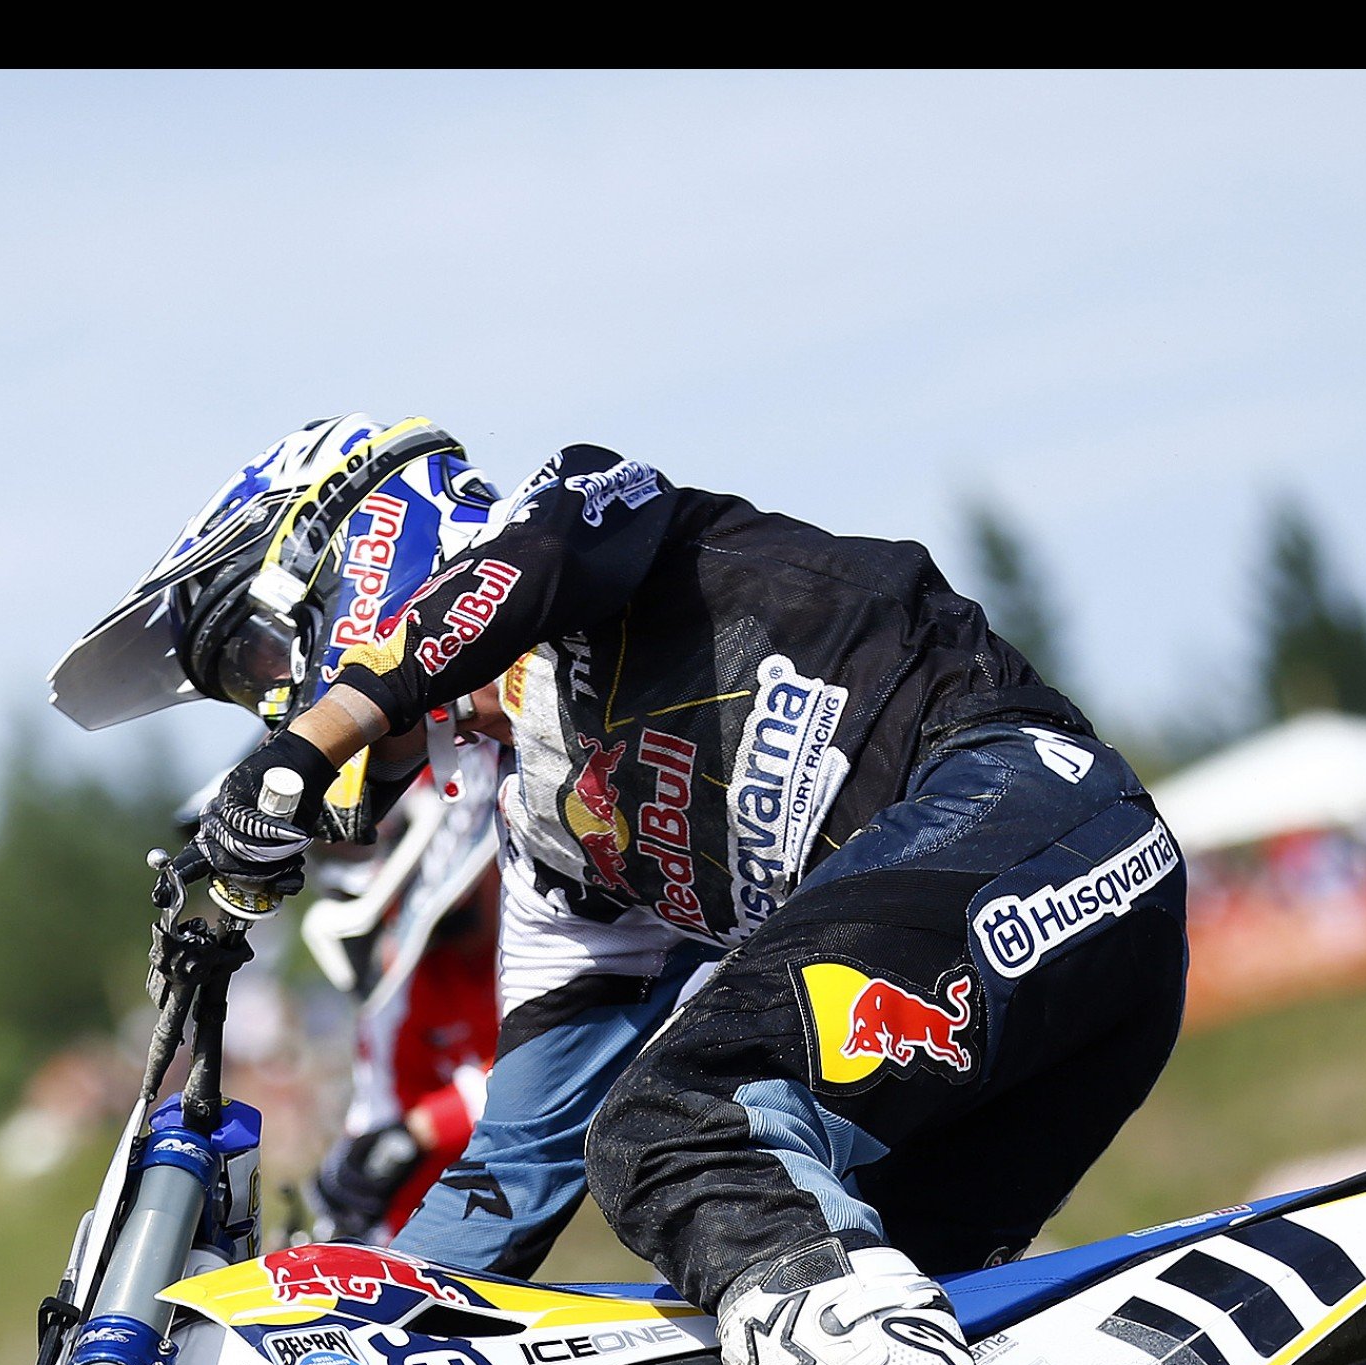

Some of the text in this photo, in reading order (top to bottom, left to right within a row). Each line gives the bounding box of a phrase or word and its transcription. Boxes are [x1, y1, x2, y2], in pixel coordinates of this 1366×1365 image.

[420, 561, 519, 673] Red Bull
[806, 697, 839, 768] RACING
[638, 730, 708, 932] Red Bull
[1030, 833, 1174, 941] Husqvarna
